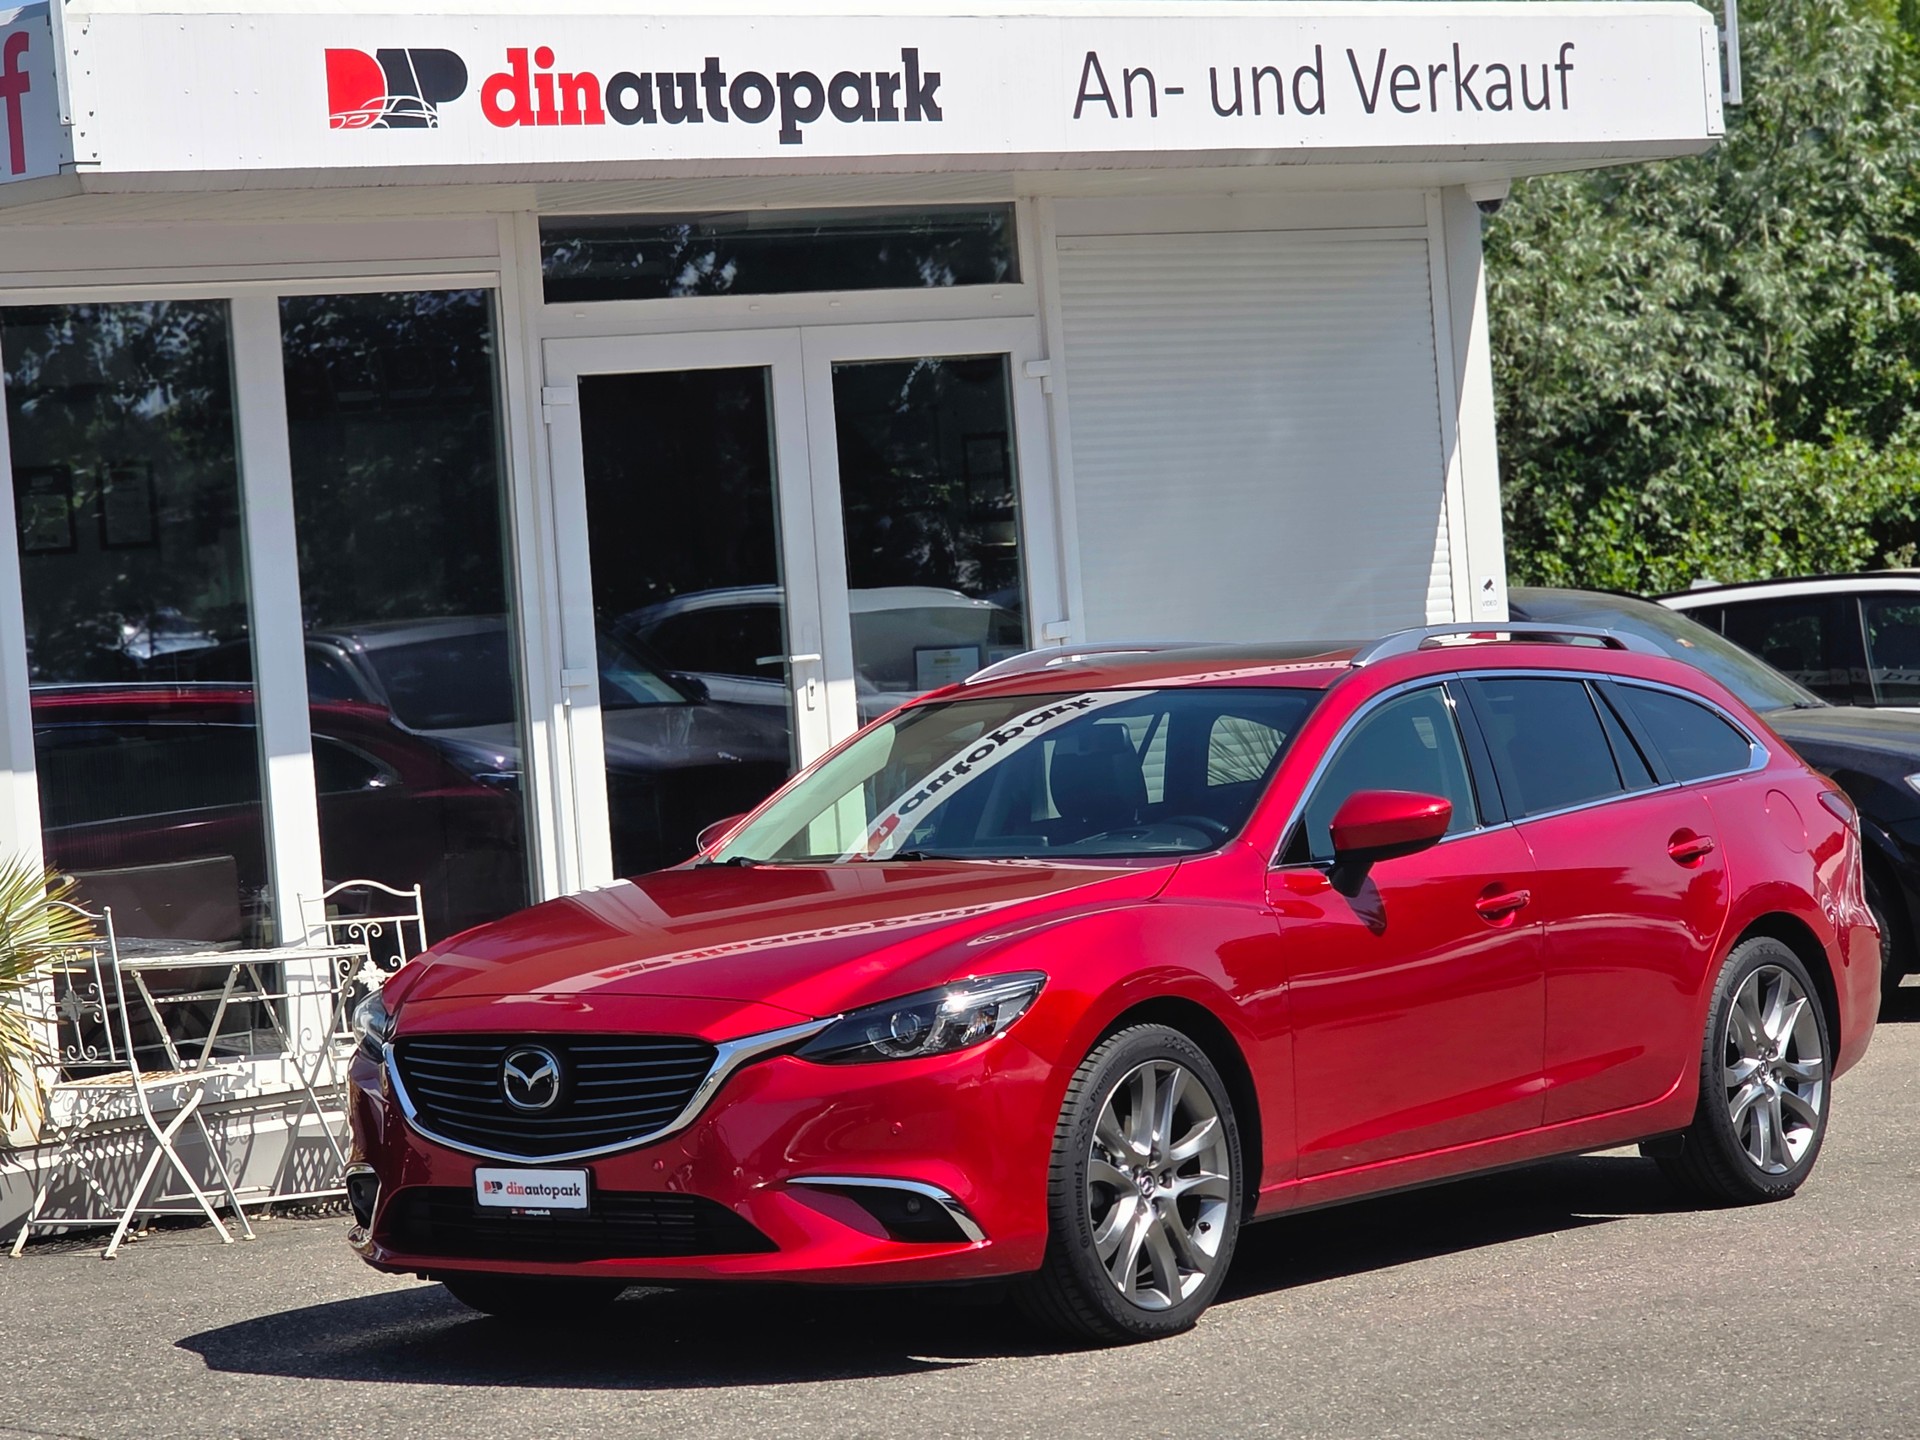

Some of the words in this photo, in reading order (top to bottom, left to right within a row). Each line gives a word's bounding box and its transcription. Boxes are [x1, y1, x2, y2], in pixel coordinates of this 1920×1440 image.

[480, 46, 943, 145] dinautopark
[1073, 51, 1185, 119] An-
[1209, 44, 1326, 117] und
[1346, 42, 1575, 114] Verkauf
[506, 1182, 581, 1199] dinautopark
